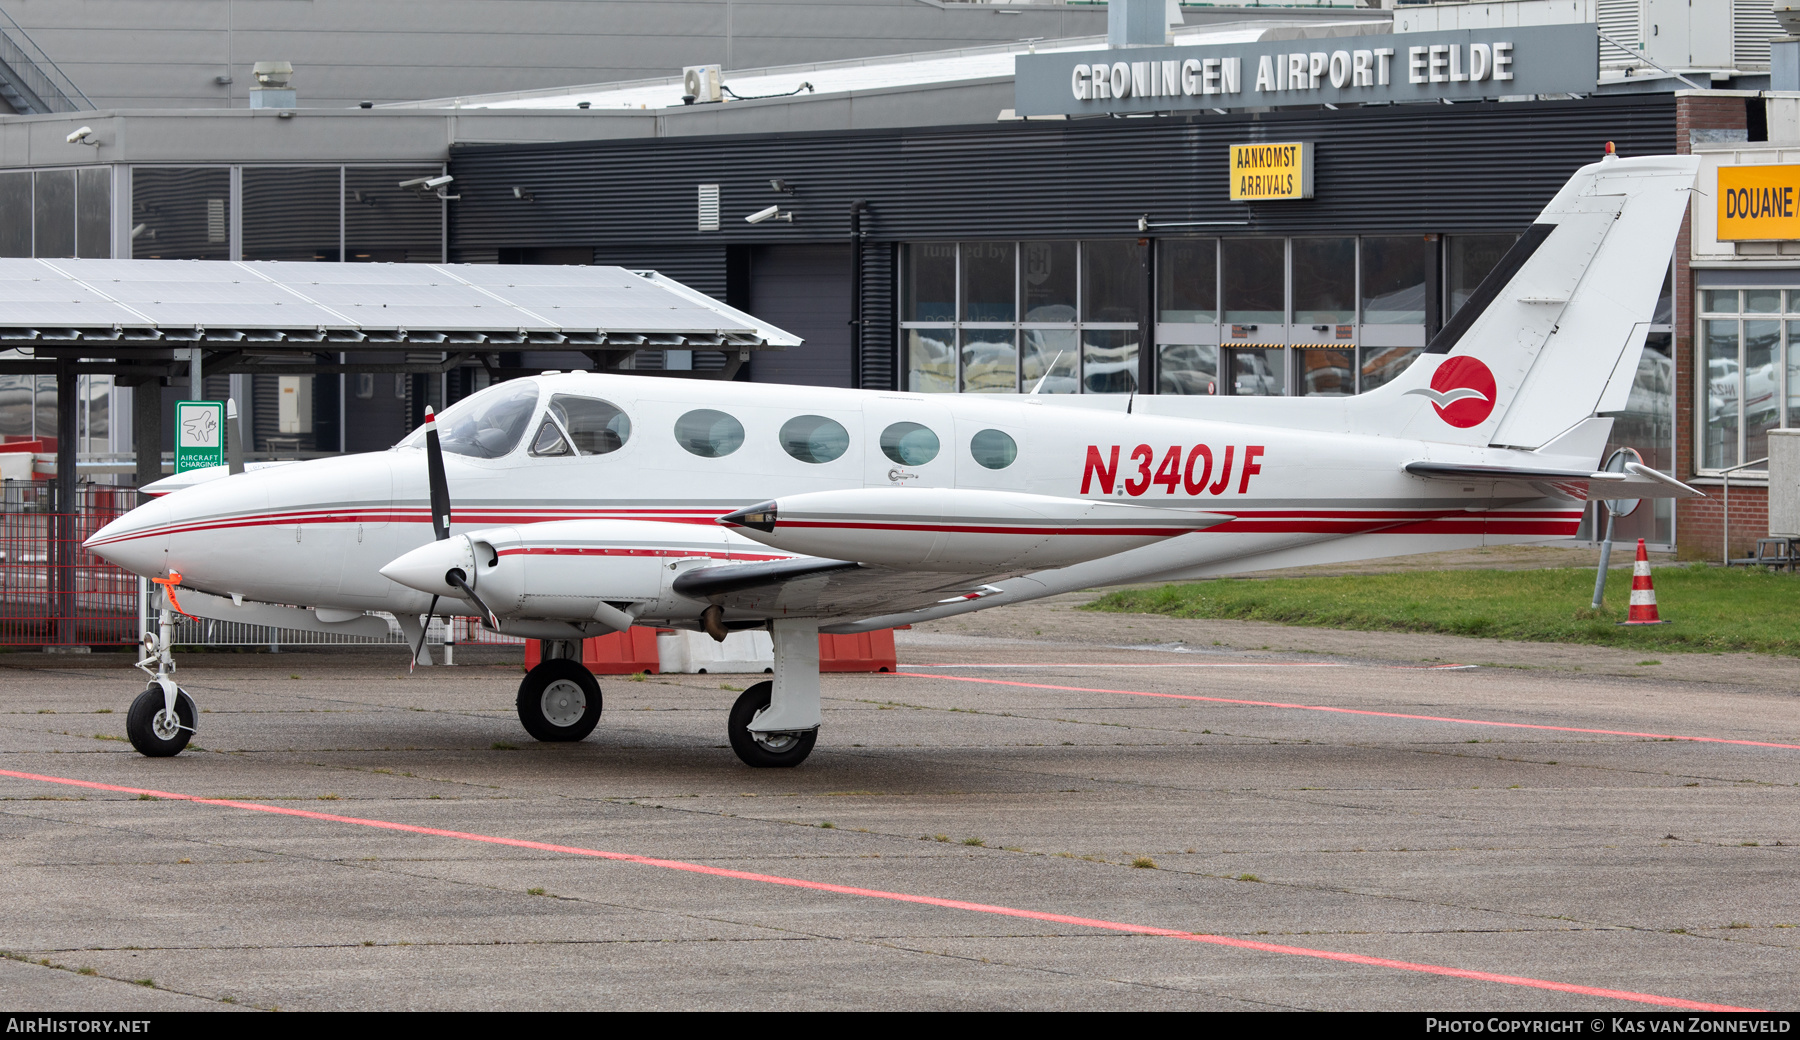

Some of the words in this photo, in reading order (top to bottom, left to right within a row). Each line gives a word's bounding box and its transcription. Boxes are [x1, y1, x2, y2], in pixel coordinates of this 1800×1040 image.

[1072, 57, 1241, 100] GRONINGEN
[1255, 48, 1394, 92] AIRPORT
[1409, 42, 1513, 84] EELDE
[1237, 146, 1296, 168] AANKOMST
[1240, 174, 1293, 196] ARRIVALS
[1727, 187, 1793, 219] DOUANE
[1080, 443, 1265, 497] N340JF
